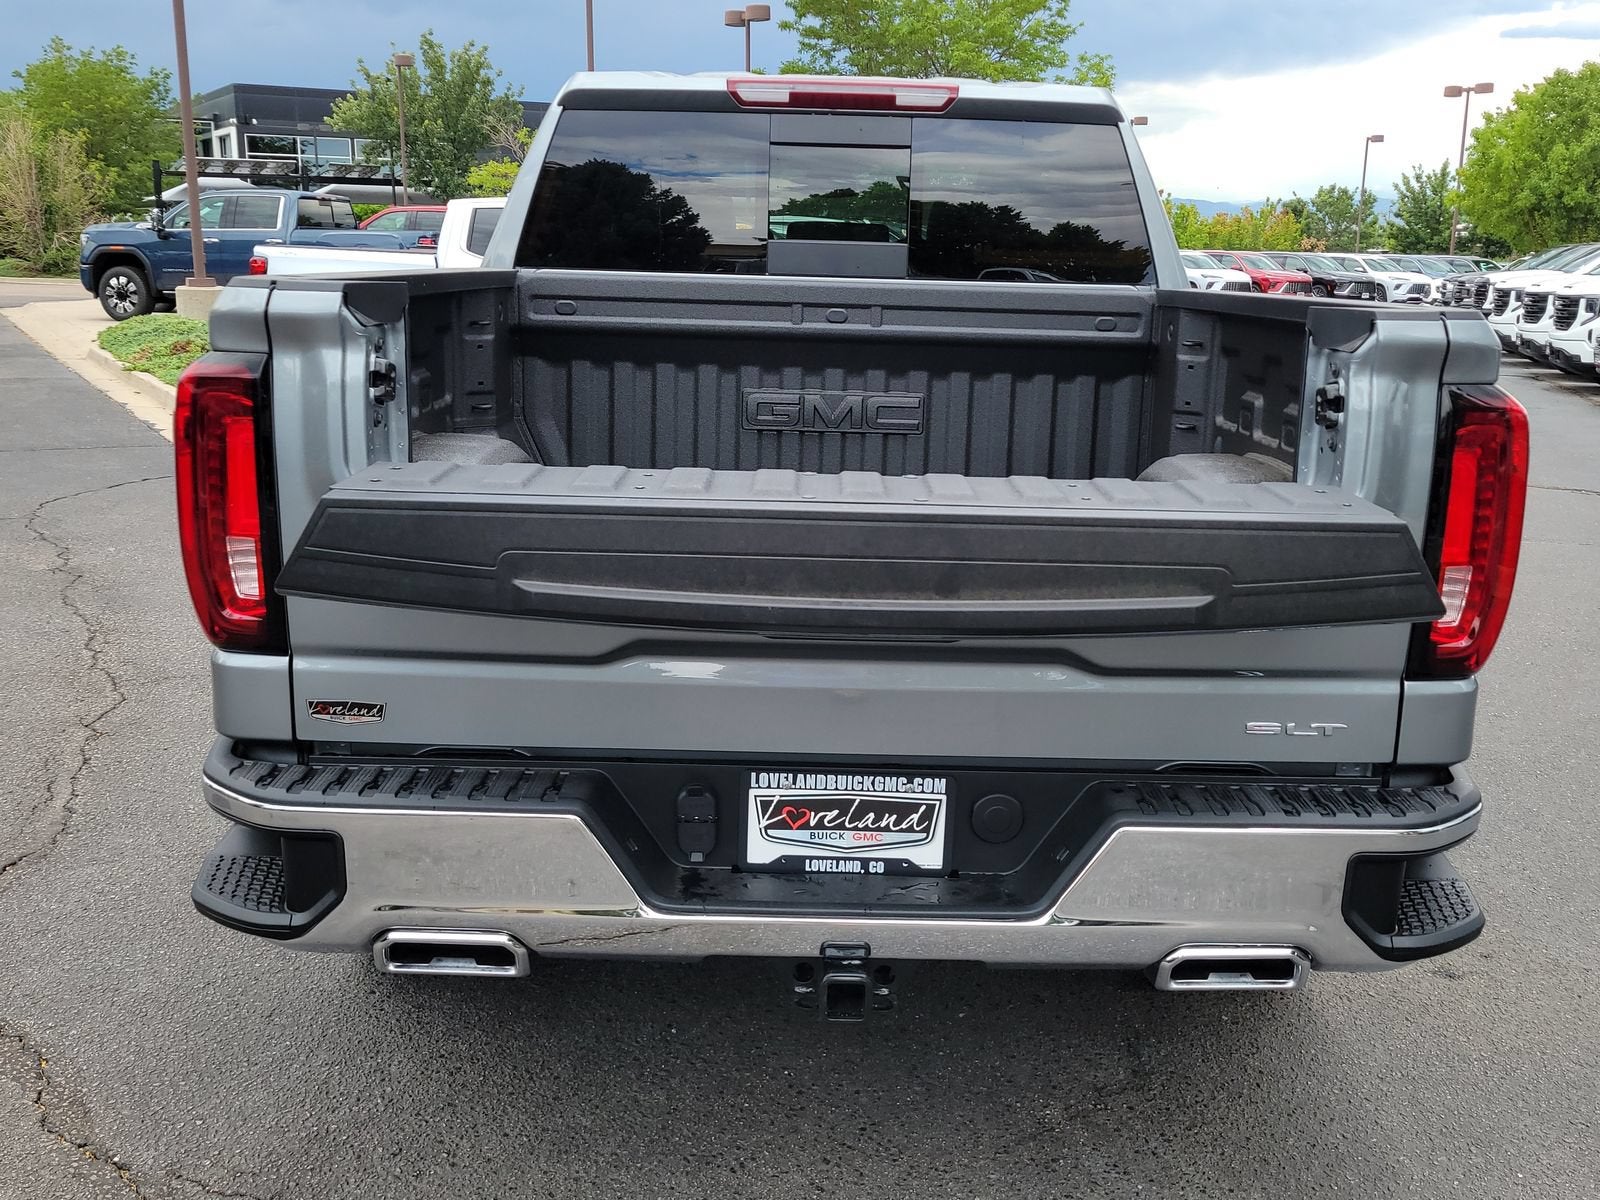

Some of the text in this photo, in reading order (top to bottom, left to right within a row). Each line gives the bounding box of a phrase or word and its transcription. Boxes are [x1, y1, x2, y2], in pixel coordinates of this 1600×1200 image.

[746, 393, 921, 432] GMC
[1245, 722, 1348, 736] SLT
[750, 772, 946, 794] LOVELANDBUICKGMCCOM
[759, 795, 929, 833] Loveland
[809, 831, 884, 842] BUICK GMC
[805, 859, 885, 874] LOVELAND, CO
